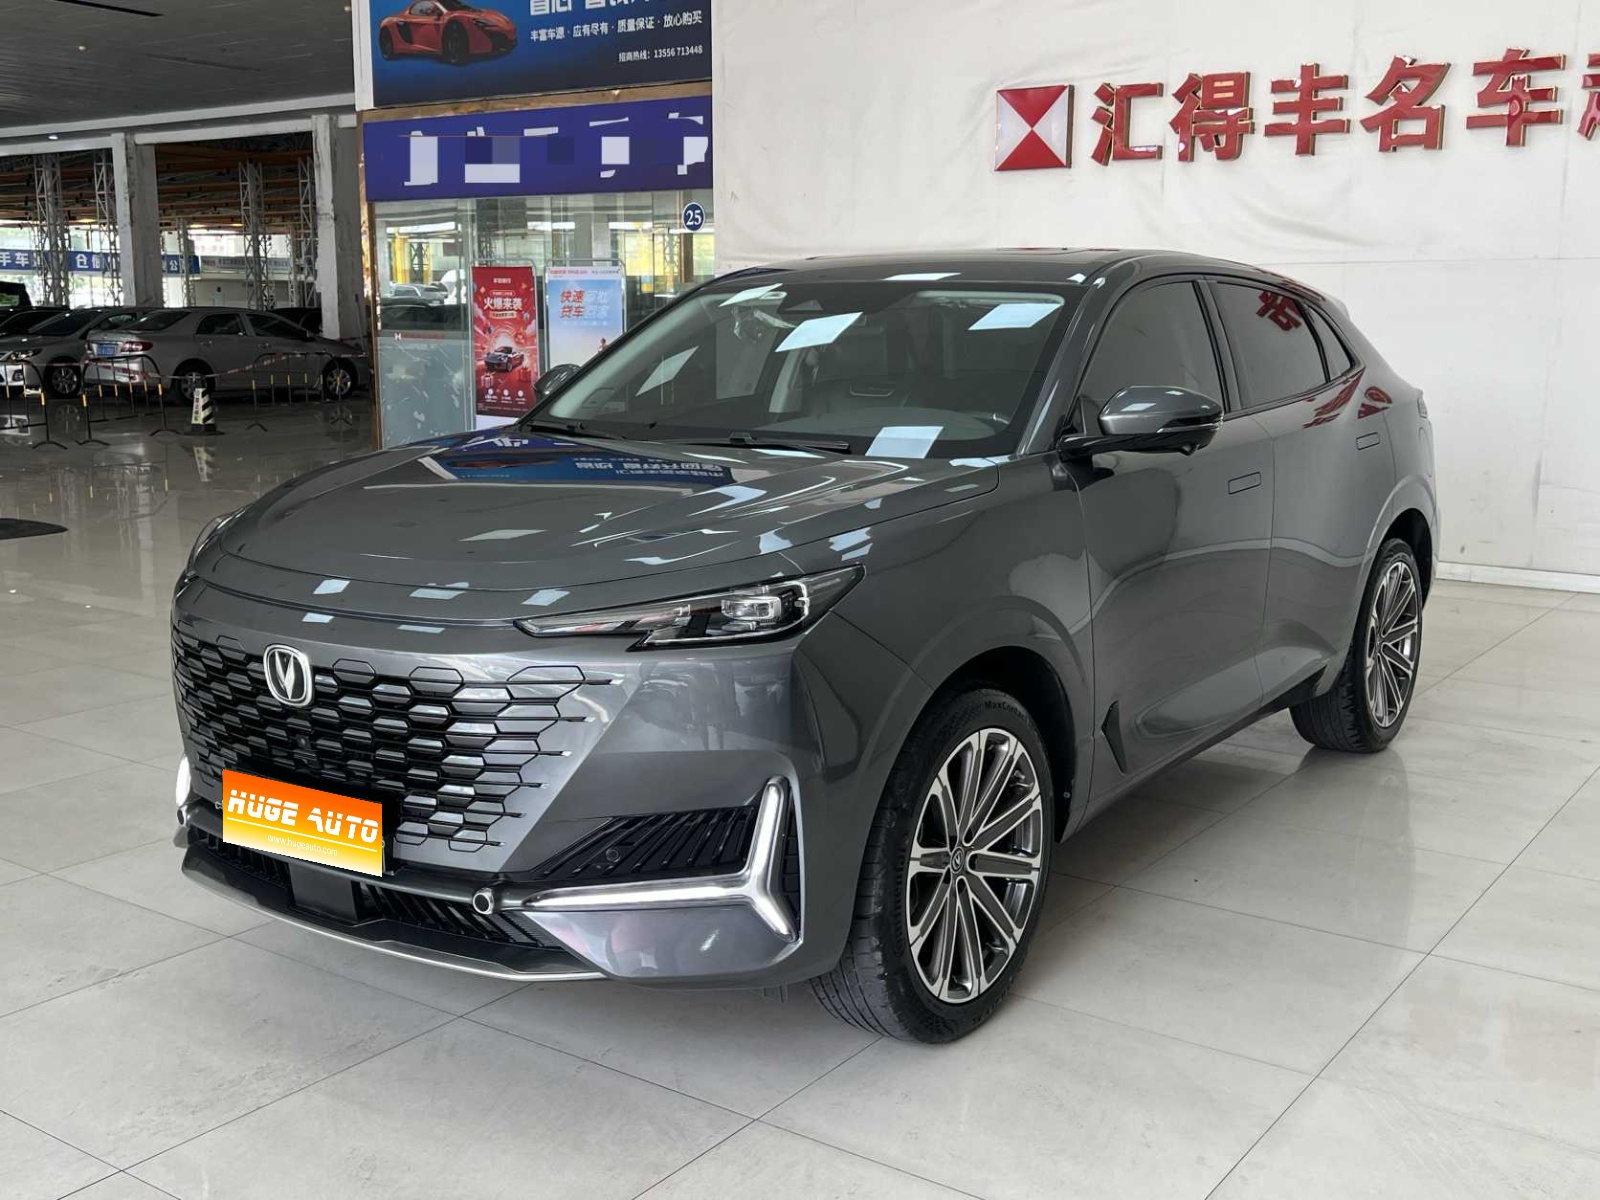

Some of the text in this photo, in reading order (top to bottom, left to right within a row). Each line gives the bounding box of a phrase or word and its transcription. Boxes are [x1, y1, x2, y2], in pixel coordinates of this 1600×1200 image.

[572, 22, 609, 38] 应有尽有
[617, 16, 655, 33] 质量保证
[663, 10, 703, 28] 放心购买
[686, 209, 701, 226] 25
[483, 296, 522, 310] 火爆来袭
